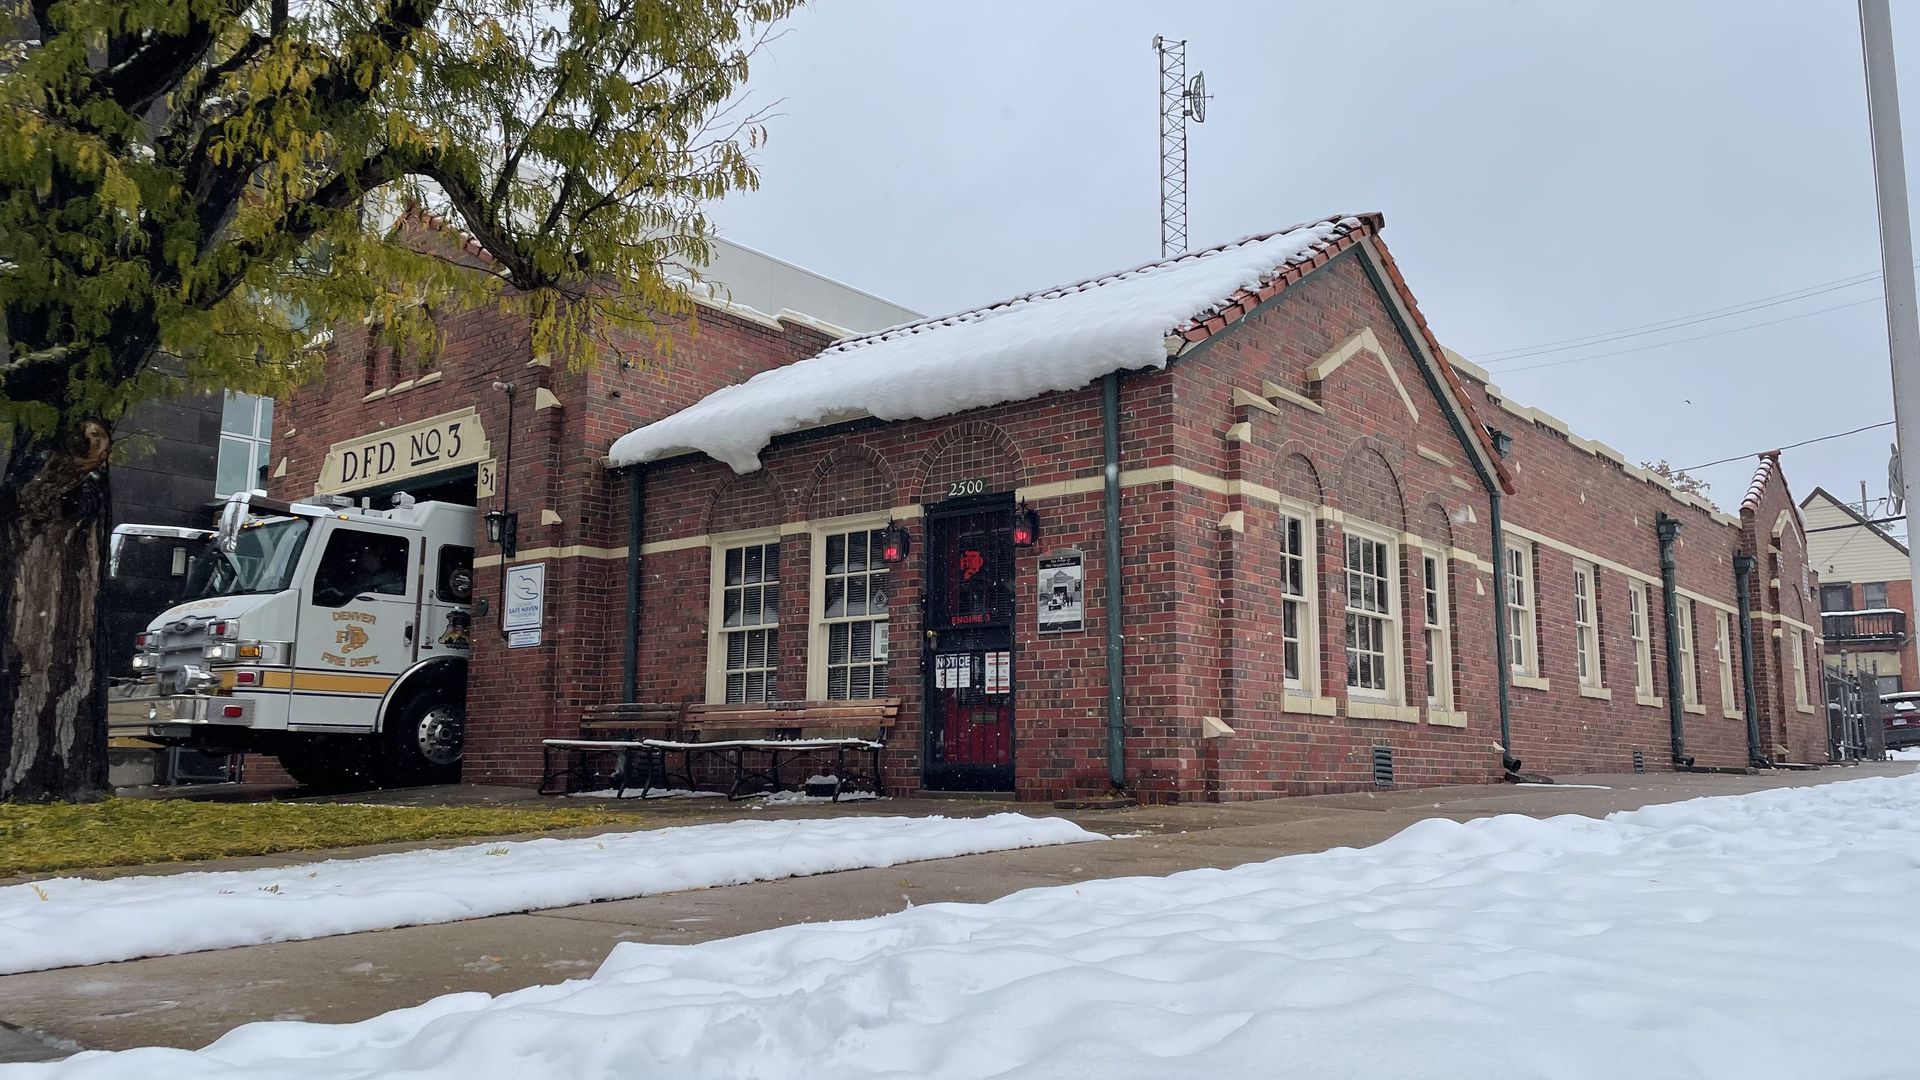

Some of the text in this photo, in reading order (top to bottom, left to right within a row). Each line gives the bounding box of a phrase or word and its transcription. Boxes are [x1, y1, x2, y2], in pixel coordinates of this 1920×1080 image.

[447, 423, 461, 458] 3
[948, 480, 983, 496] 2500
[332, 611, 376, 625] DENVER
[951, 613, 990, 624] ENGINE 3
[321, 652, 346, 666] FIRE
[936, 656, 971, 668] NOTICE
